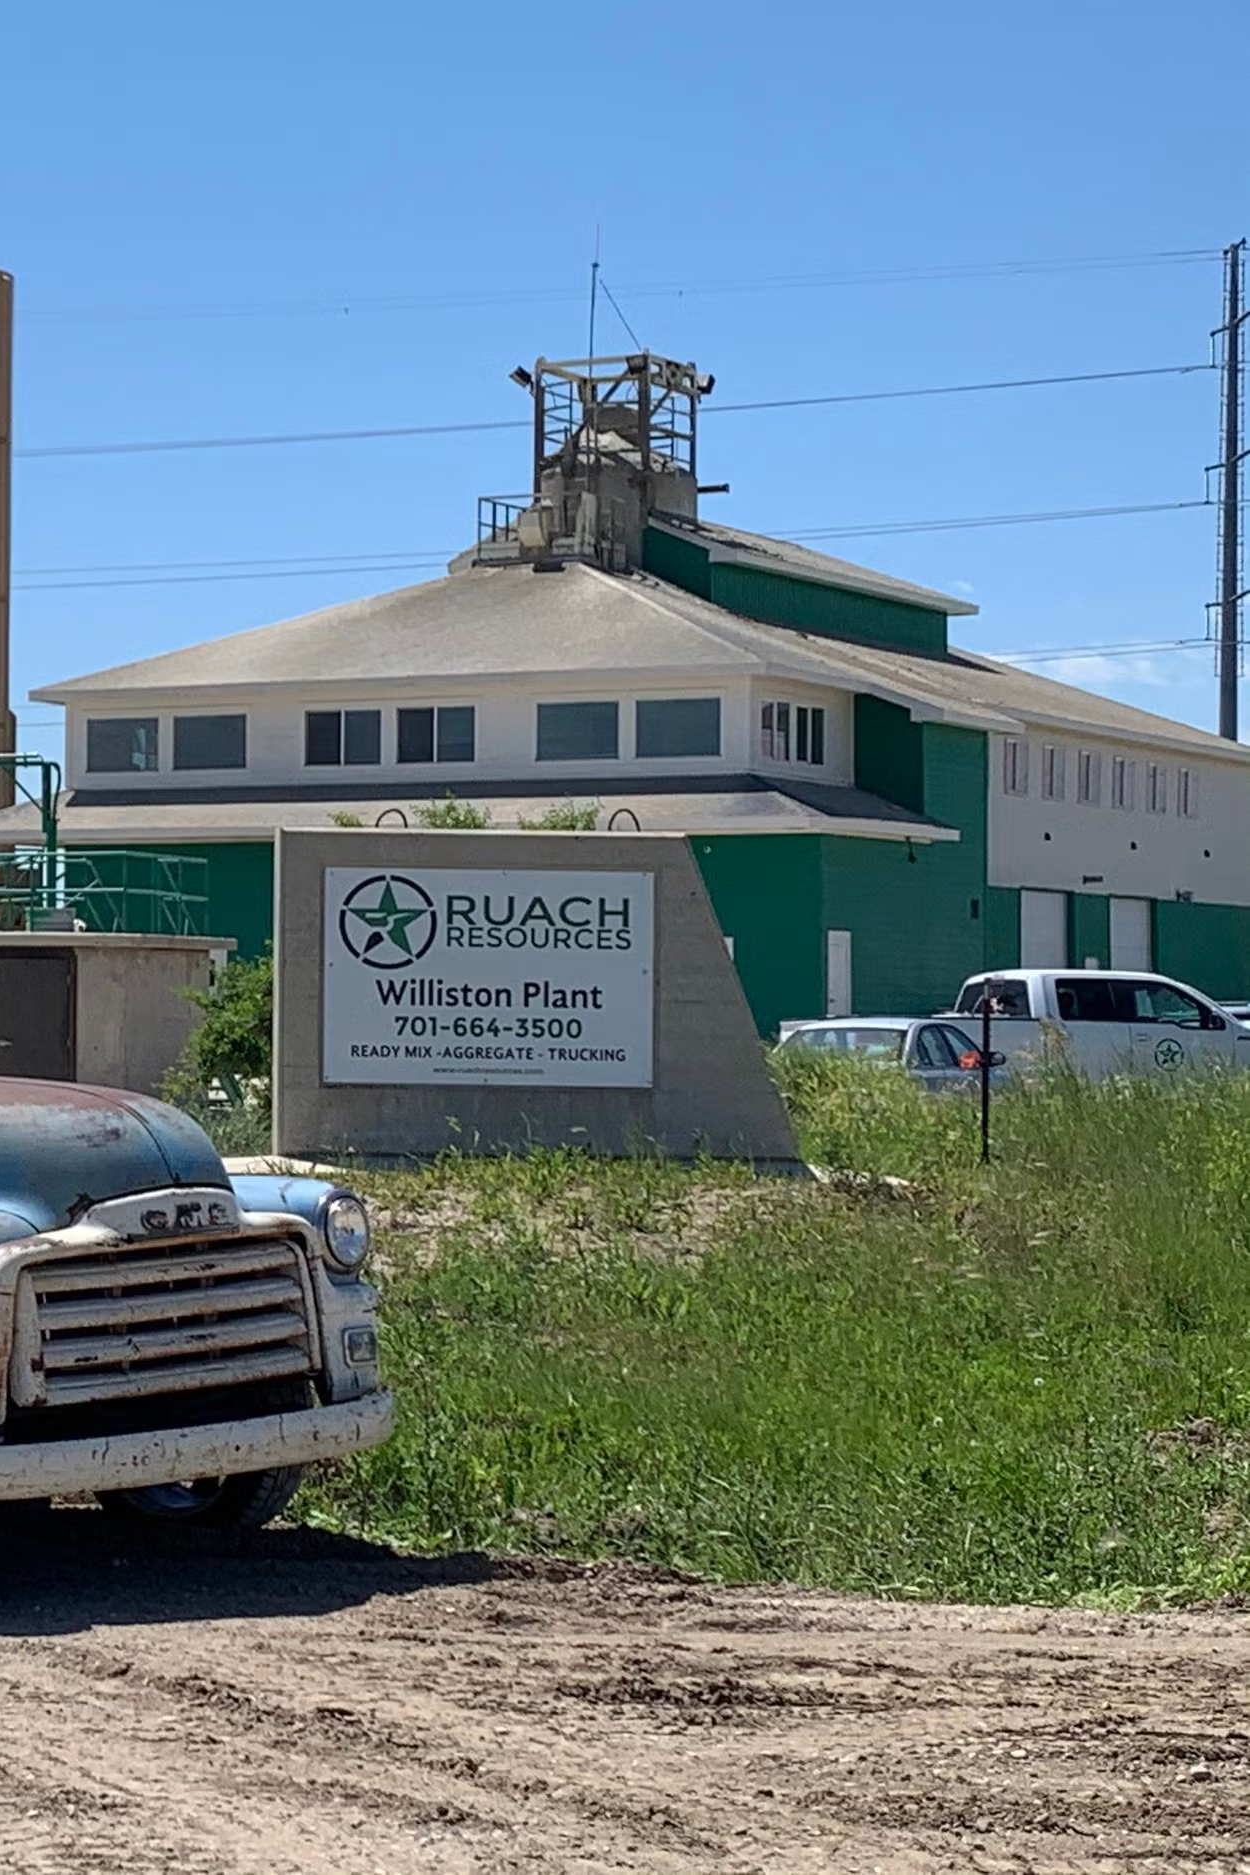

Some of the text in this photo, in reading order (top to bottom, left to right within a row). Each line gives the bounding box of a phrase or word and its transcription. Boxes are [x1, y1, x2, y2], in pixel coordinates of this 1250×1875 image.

[446, 895, 630, 928] RUACH
[446, 926, 632, 950] RESOURCES
[375, 978, 603, 1009] Williston Plant
[394, 1016, 583, 1039] 701-664-3500
[350, 1045, 400, 1058] READY
[404, 1046, 432, 1059] MIX
[549, 1048, 626, 1062] TRUCKING
